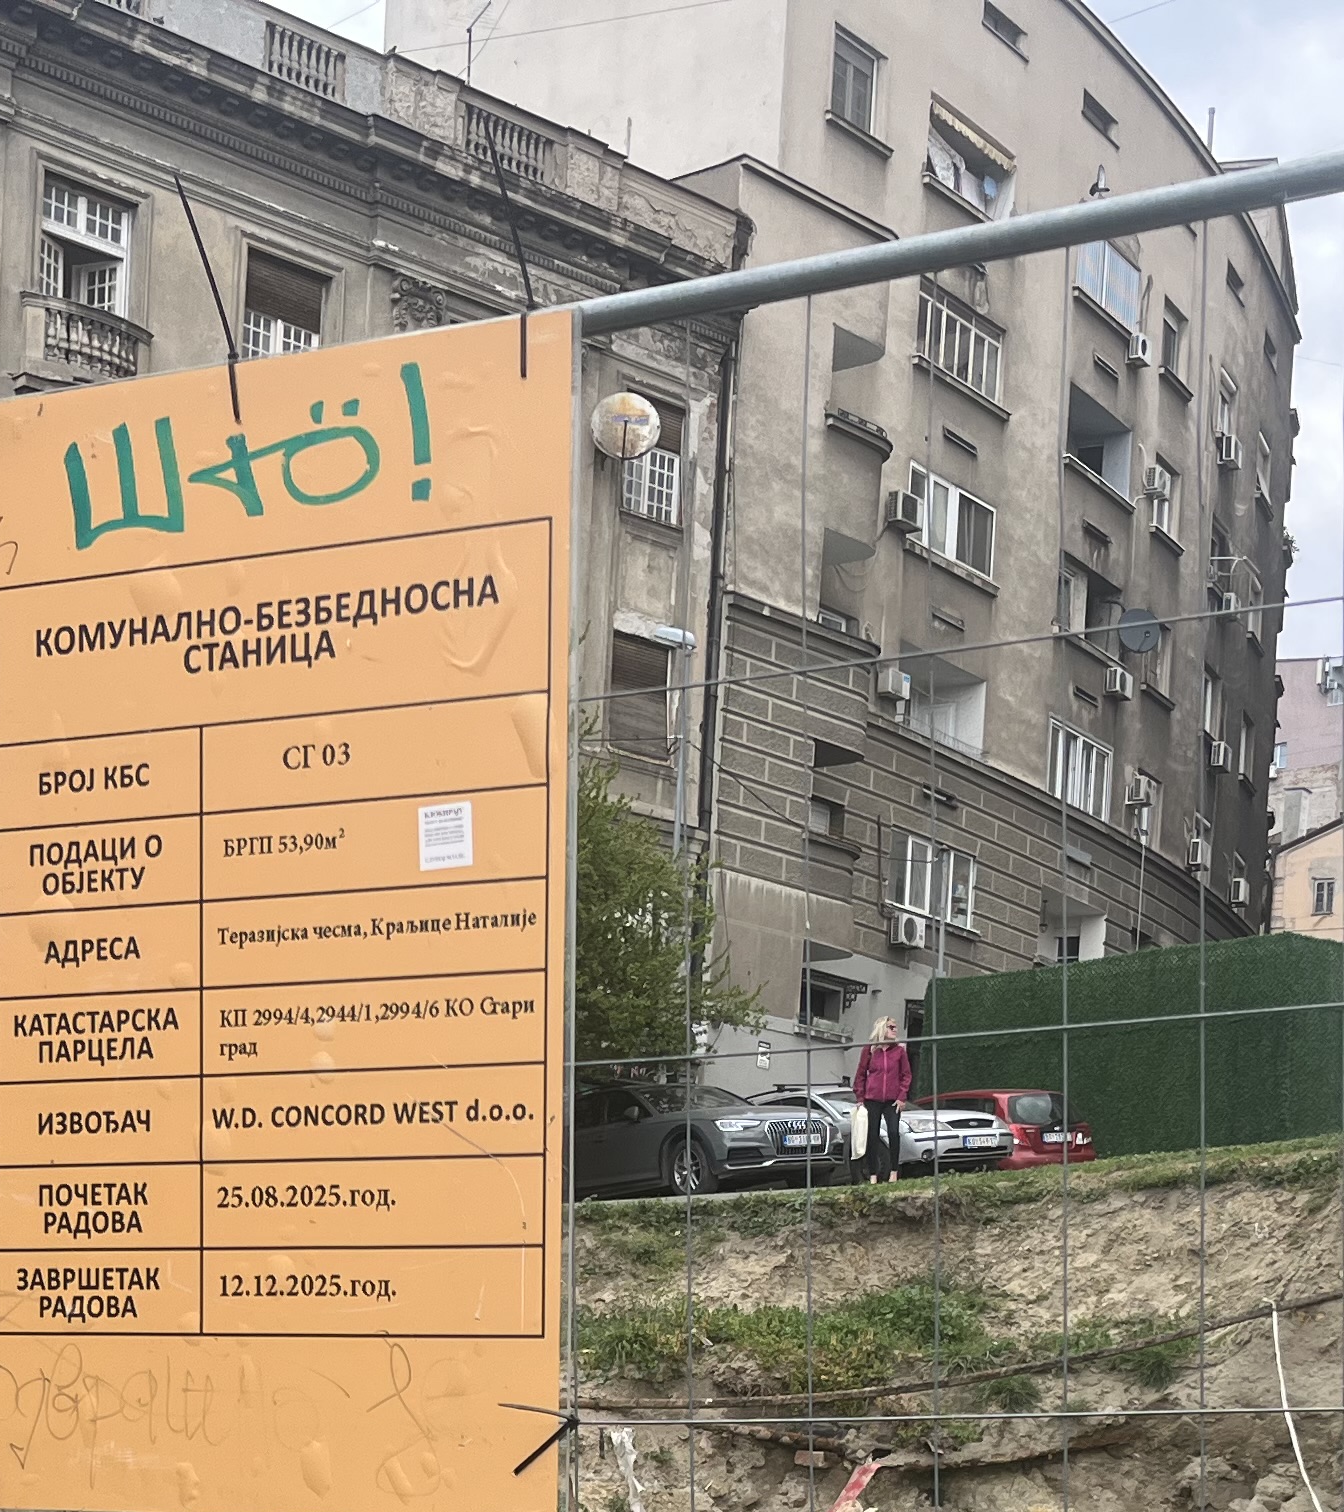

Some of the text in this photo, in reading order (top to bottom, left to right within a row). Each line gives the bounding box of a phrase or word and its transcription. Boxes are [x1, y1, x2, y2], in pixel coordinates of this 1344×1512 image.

[35, 575, 499, 657] КОМУНАЛНО-БЕЗБЕДНОСНА
[183, 630, 336, 674] СТАНИЦА
[282, 742, 351, 770] СГ 03
[39, 763, 150, 796] БРОЈ КБС
[29, 834, 162, 871] ПОДАЦИ О
[223, 836, 273, 858] БРГП
[42, 866, 146, 896] ОБЈЕКТУ
[217, 908, 537, 949] Теразијска чесма, Краљице Наталије
[45, 937, 140, 967] АДРЕСА
[14, 1007, 179, 1038] КАТАСТАРСКА
[220, 996, 535, 1028] КП 2994/4,2944/1,2994/6 КО Стари
[38, 1038, 154, 1067] ПАРЦЕЛА
[220, 1041, 258, 1061] град
[38, 1110, 152, 1136] ИЗВОЂАЧ
[212, 1099, 534, 1130] W.D. CONCORD WEST d.o.o.
[39, 1182, 149, 1208] ПОЧЕТАК
[217, 1185, 396, 1211] 25.08.2025.год.
[44, 1211, 143, 1240] РАДОВА
[17, 1267, 160, 1292] ЗАВРШЕТАК
[219, 1274, 397, 1301] 12.12.2025.год.
[39, 1295, 138, 1323] РАДОВА
